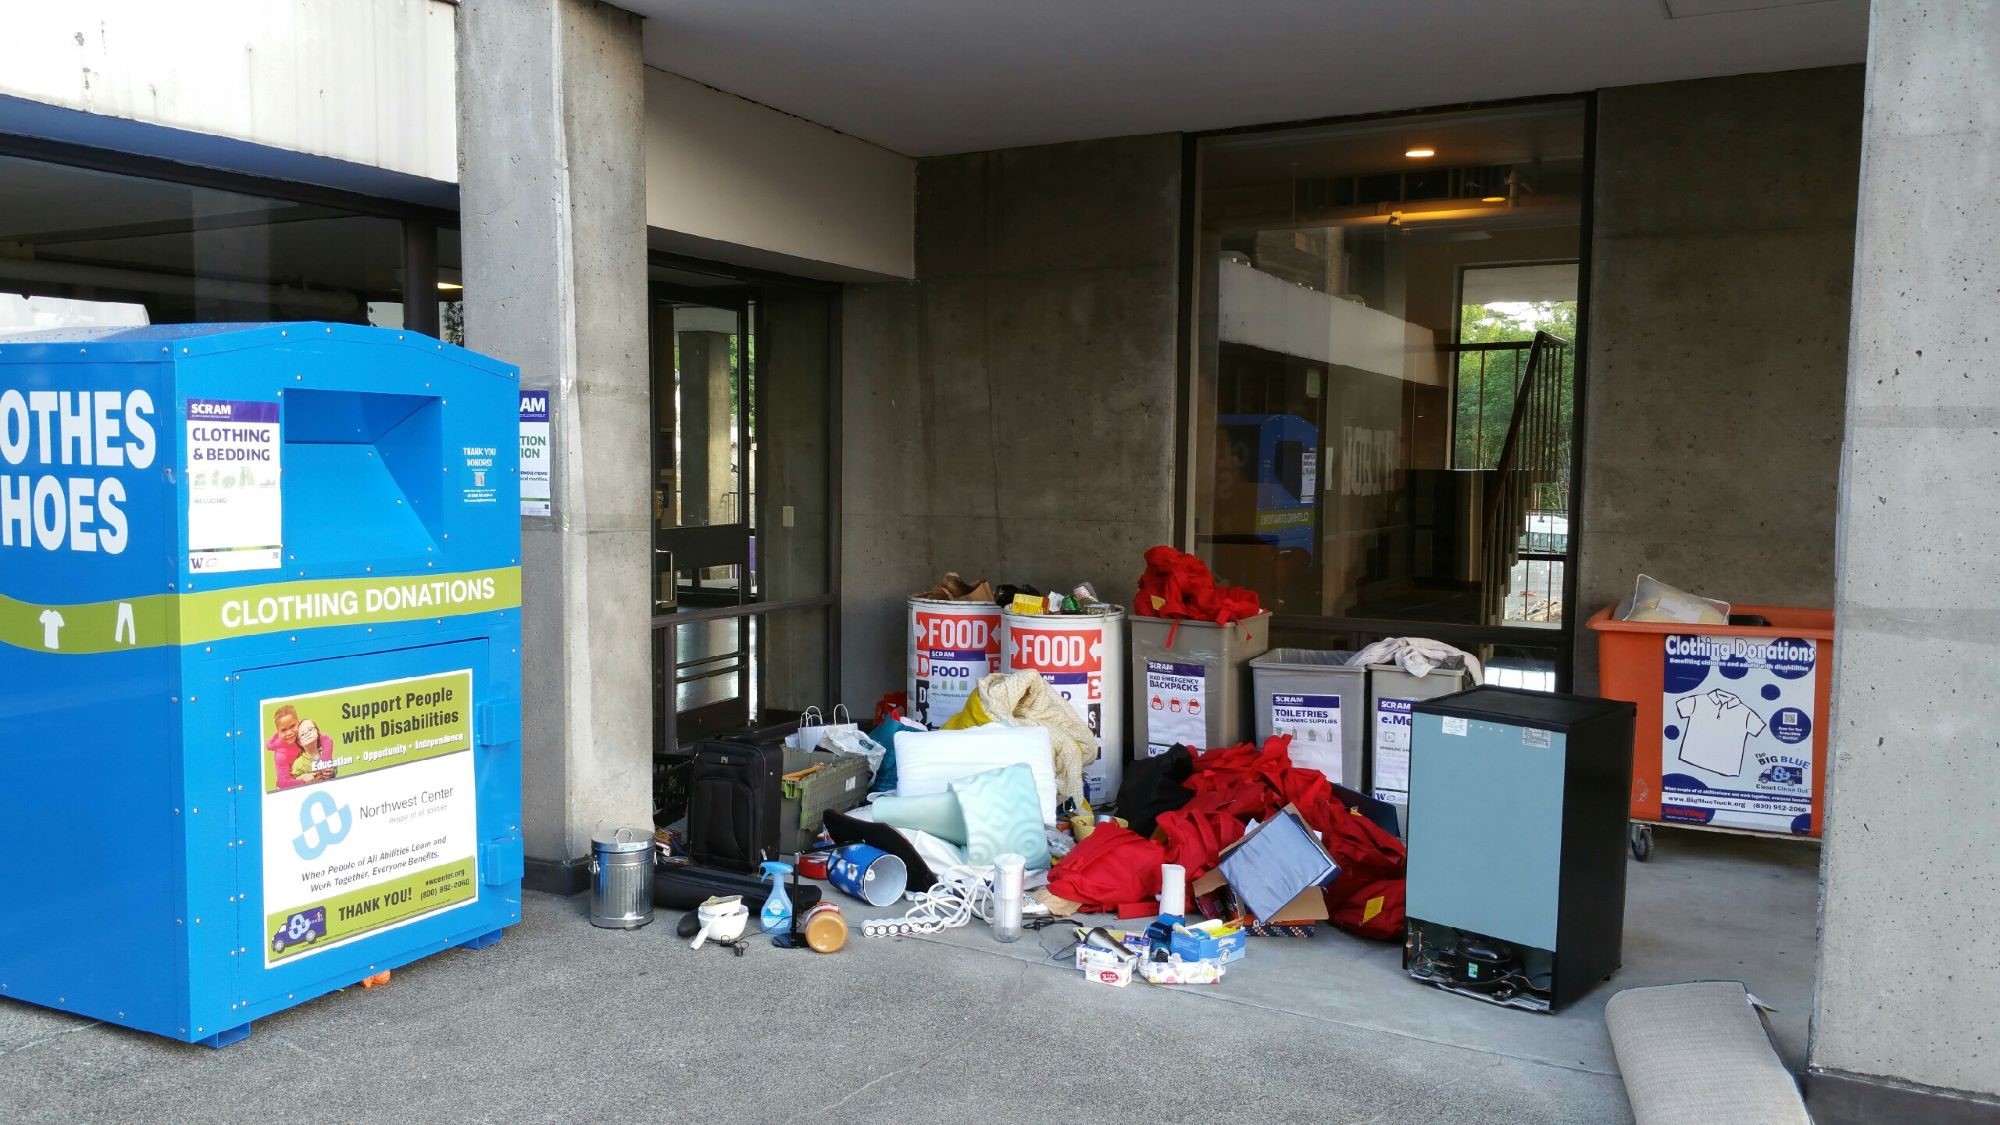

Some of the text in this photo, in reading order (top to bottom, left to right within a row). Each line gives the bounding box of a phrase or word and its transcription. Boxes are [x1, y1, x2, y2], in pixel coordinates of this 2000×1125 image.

[191, 403, 232, 415] SCRAM
[193, 428, 270, 443] CLOTHING
[193, 448, 270, 461] & BEDDING
[463, 447, 496, 456] THANK YOU
[221, 577, 495, 628] CLOTHING DONATIONS
[928, 618, 988, 649] FOOD
[1021, 634, 1085, 667] FOOD
[1665, 635, 1815, 661] Clothing Donations
[931, 665, 969, 677] FOOD
[1149, 662, 1173, 671] SCRAM
[1149, 680, 1199, 692] BACKPACKS
[1161, 676, 1199, 685] EMERGENCY
[341, 687, 453, 720] Support People
[1381, 700, 1411, 710] SCRAM
[1275, 708, 1328, 718] TOILETRIES
[342, 710, 459, 745] with Disabilities
[311, 731, 464, 771] Education Opportunity Independence
[1758, 755, 1811, 770] BIG BLUE
[1777, 784, 1796, 792] Clean
[360, 787, 454, 820] Northwest Center
[301, 835, 447, 882] When People of All Abilities Learn and
[310, 881, 332, 893] Work
[372, 862, 407, 876] Everyone
[408, 851, 440, 866] Benefits.
[420, 888, 438, 901] (800)
[338, 897, 380, 921] THANK
[384, 887, 412, 907] YOU!
